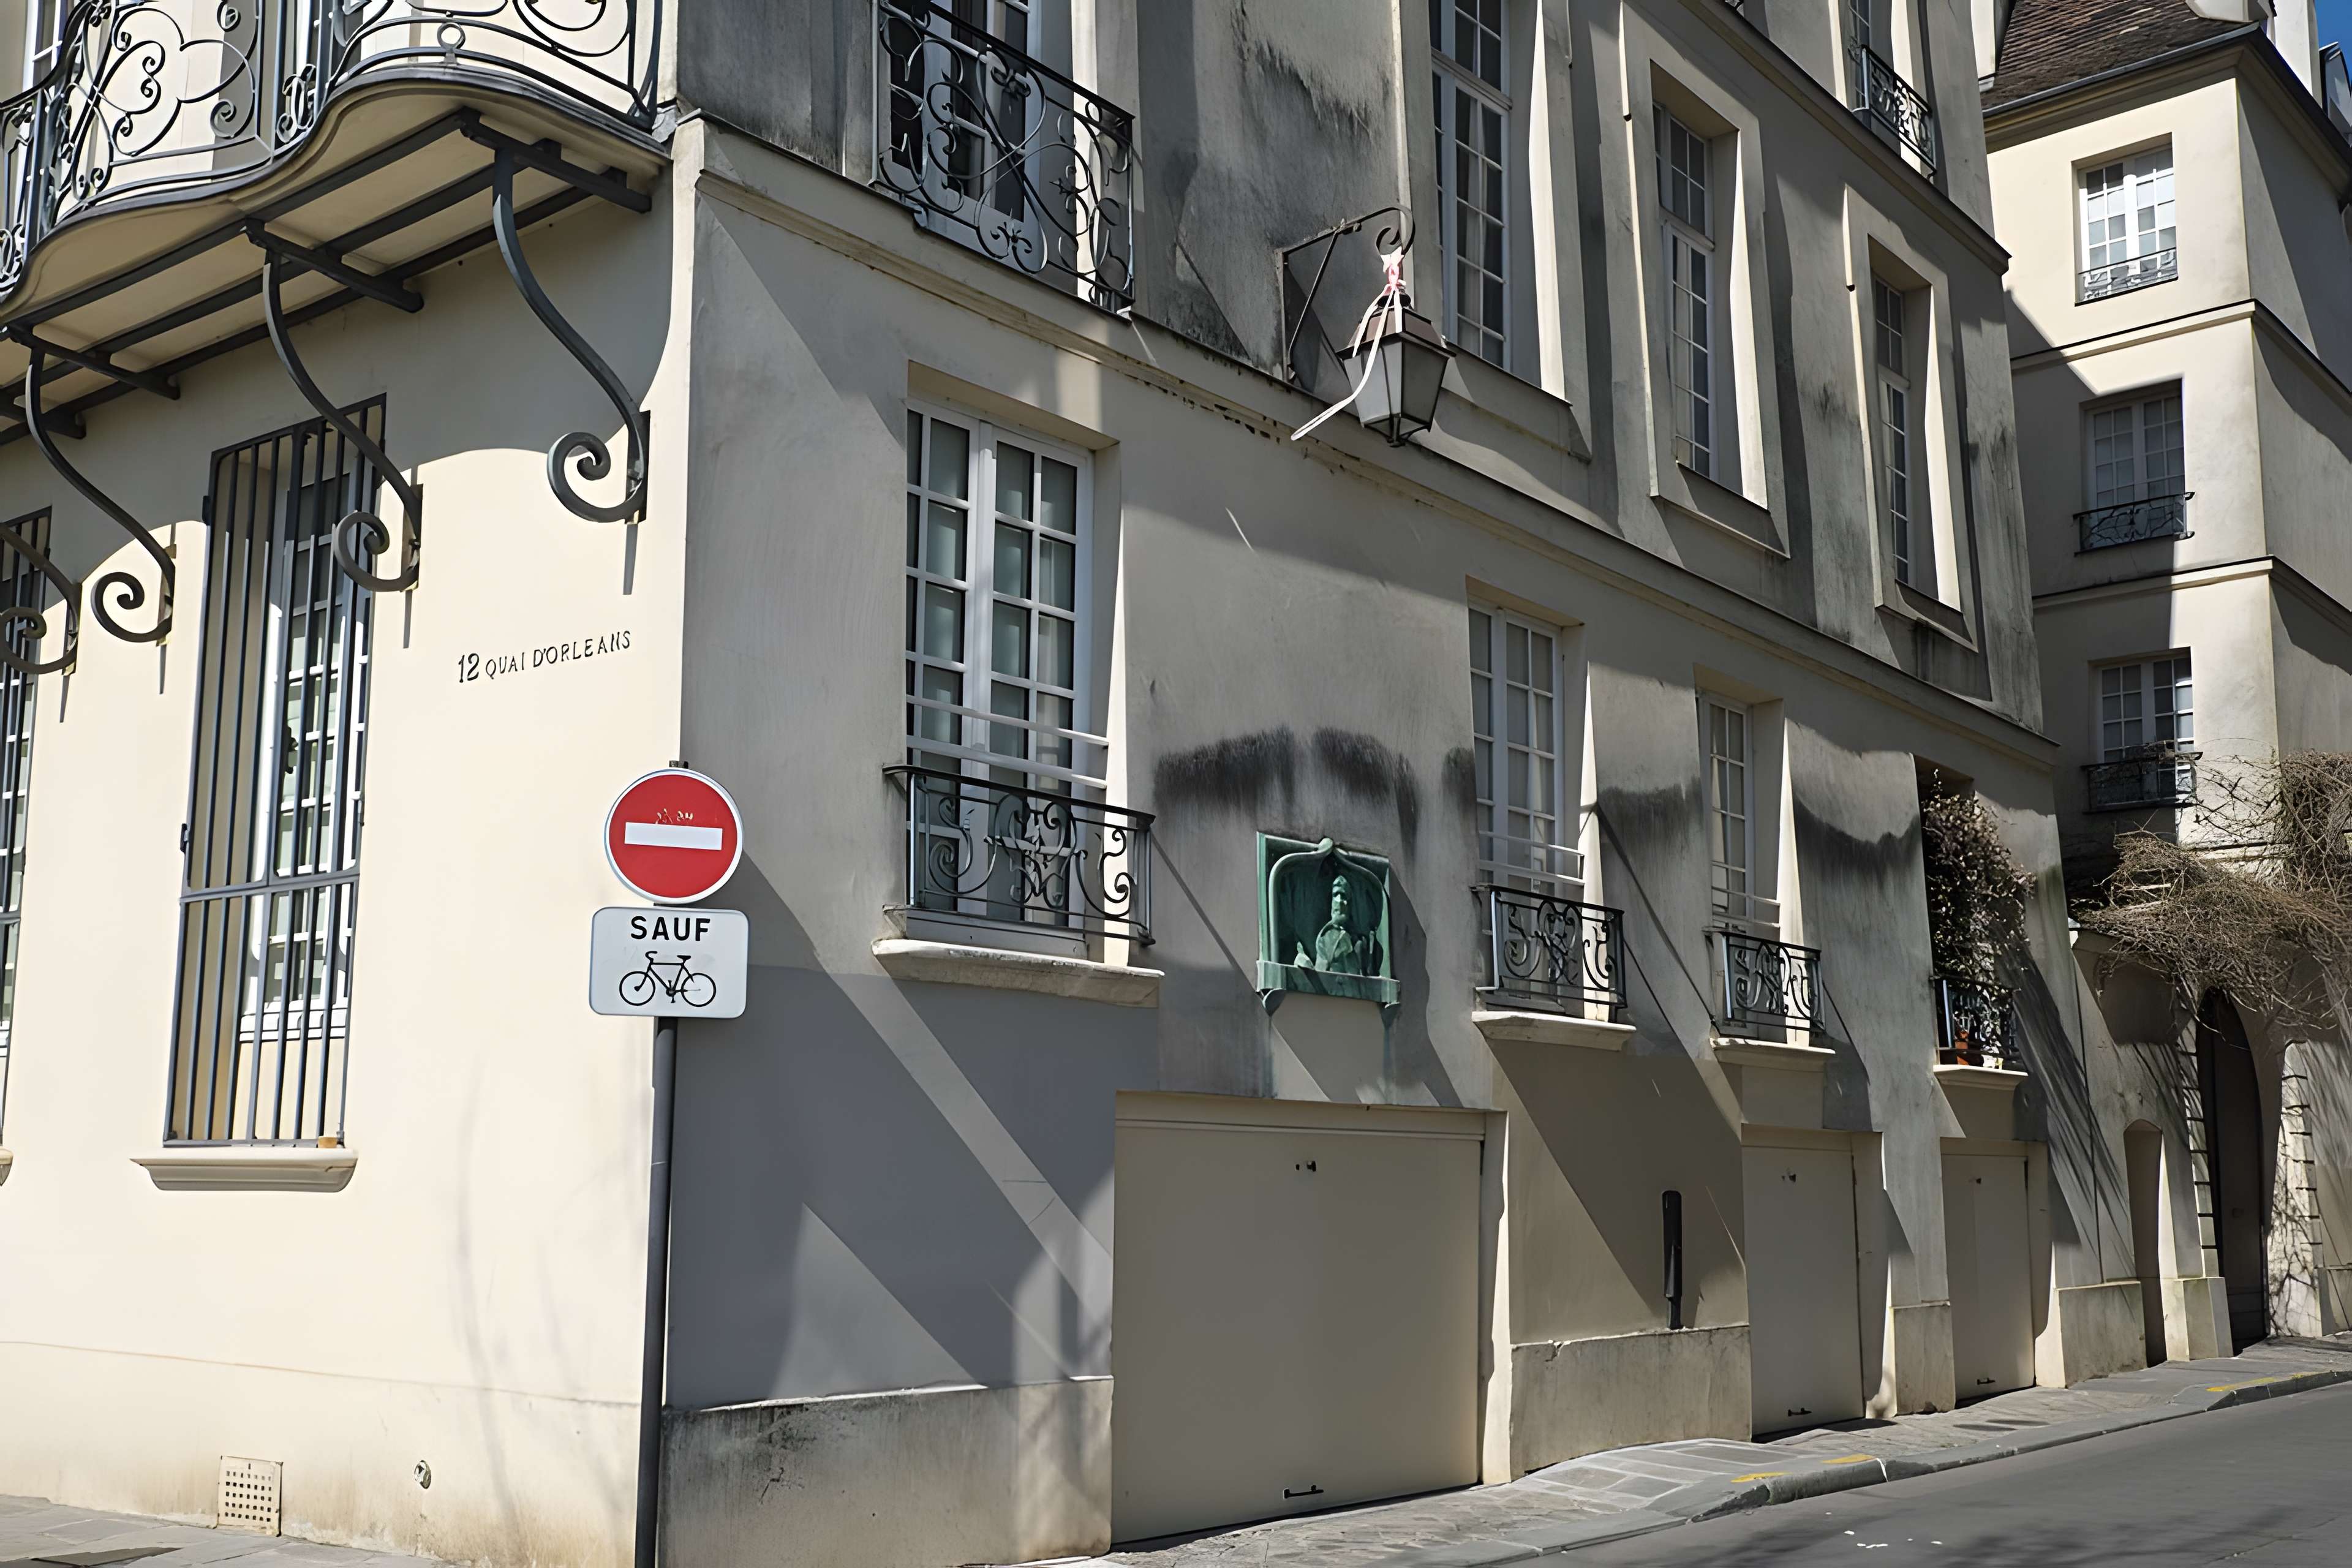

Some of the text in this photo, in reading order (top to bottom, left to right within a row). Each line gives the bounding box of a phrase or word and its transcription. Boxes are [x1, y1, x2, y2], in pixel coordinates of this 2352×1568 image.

[458, 653, 480, 683] 12
[486, 652, 525, 679] QUAI
[630, 916, 710, 941] SAUF
